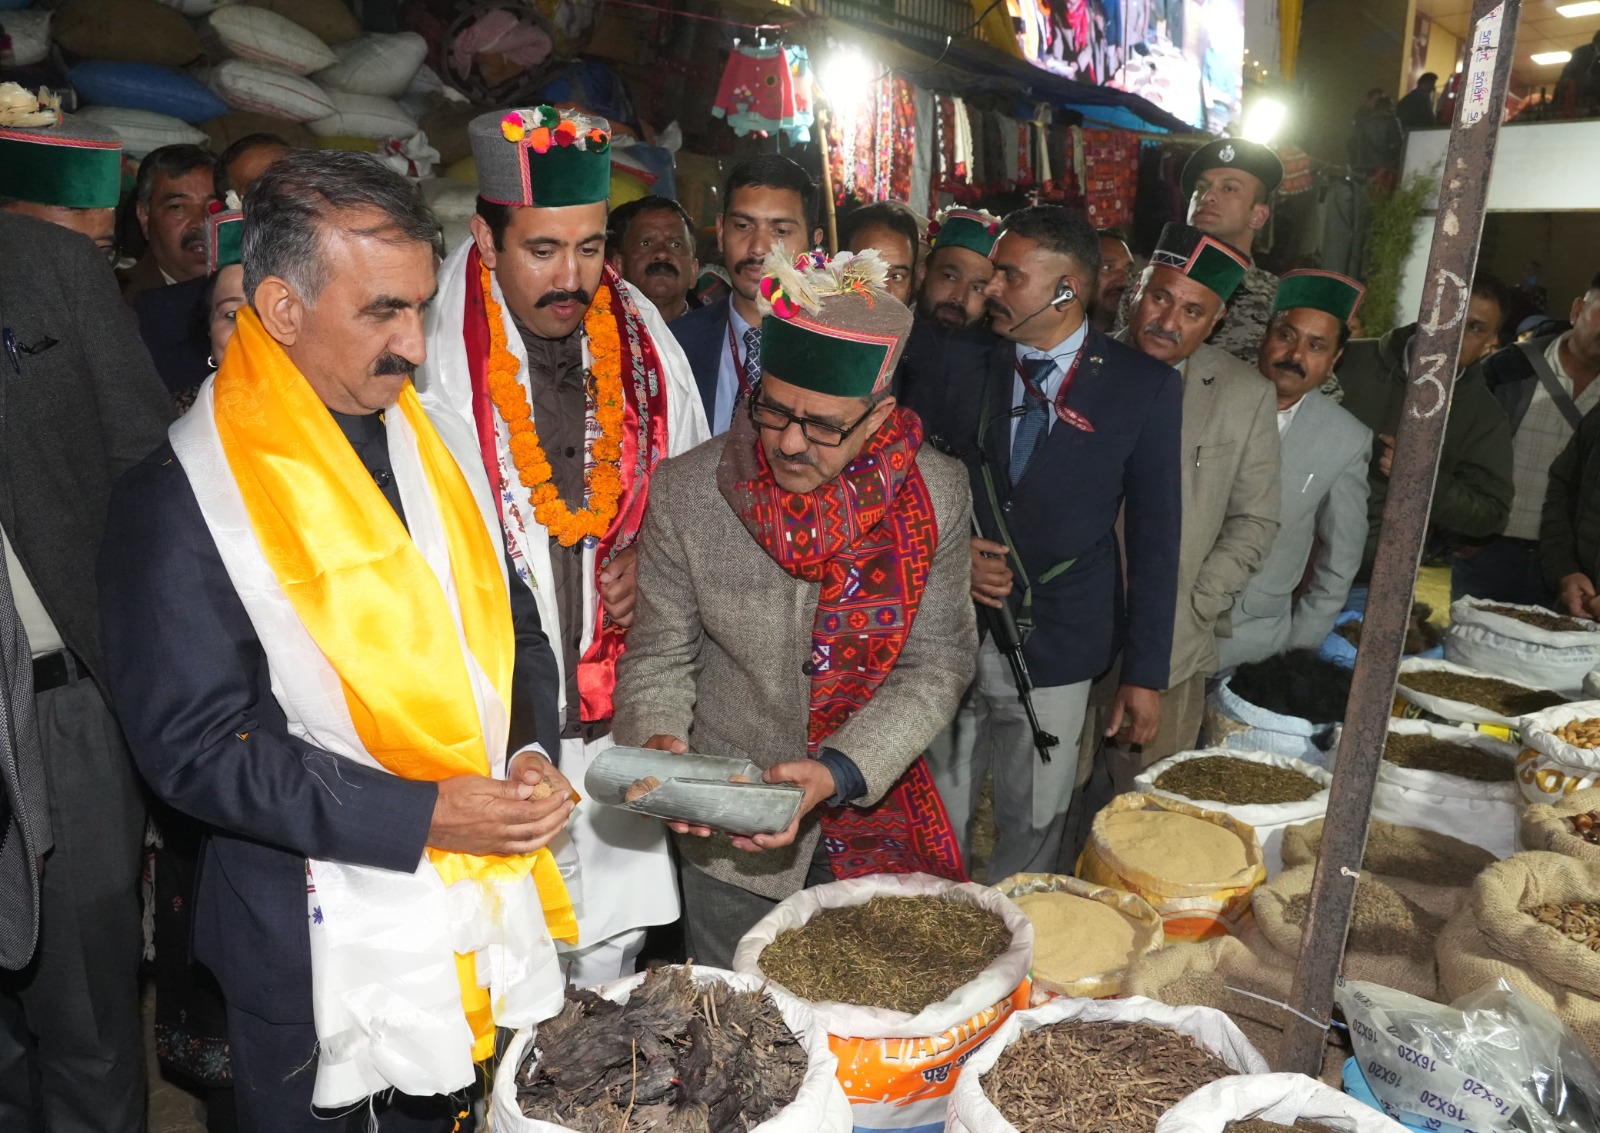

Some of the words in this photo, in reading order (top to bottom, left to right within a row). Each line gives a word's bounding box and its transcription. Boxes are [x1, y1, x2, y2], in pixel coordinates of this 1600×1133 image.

[1472, 71, 1485, 104] smart
[1352, 1018, 1378, 1044] 16X20
[1398, 1045, 1436, 1073] 16X20
[1368, 1061, 1403, 1088] 16X20
[1420, 1090, 1467, 1122] 16X20
[1462, 1078, 1511, 1116] 16X20
